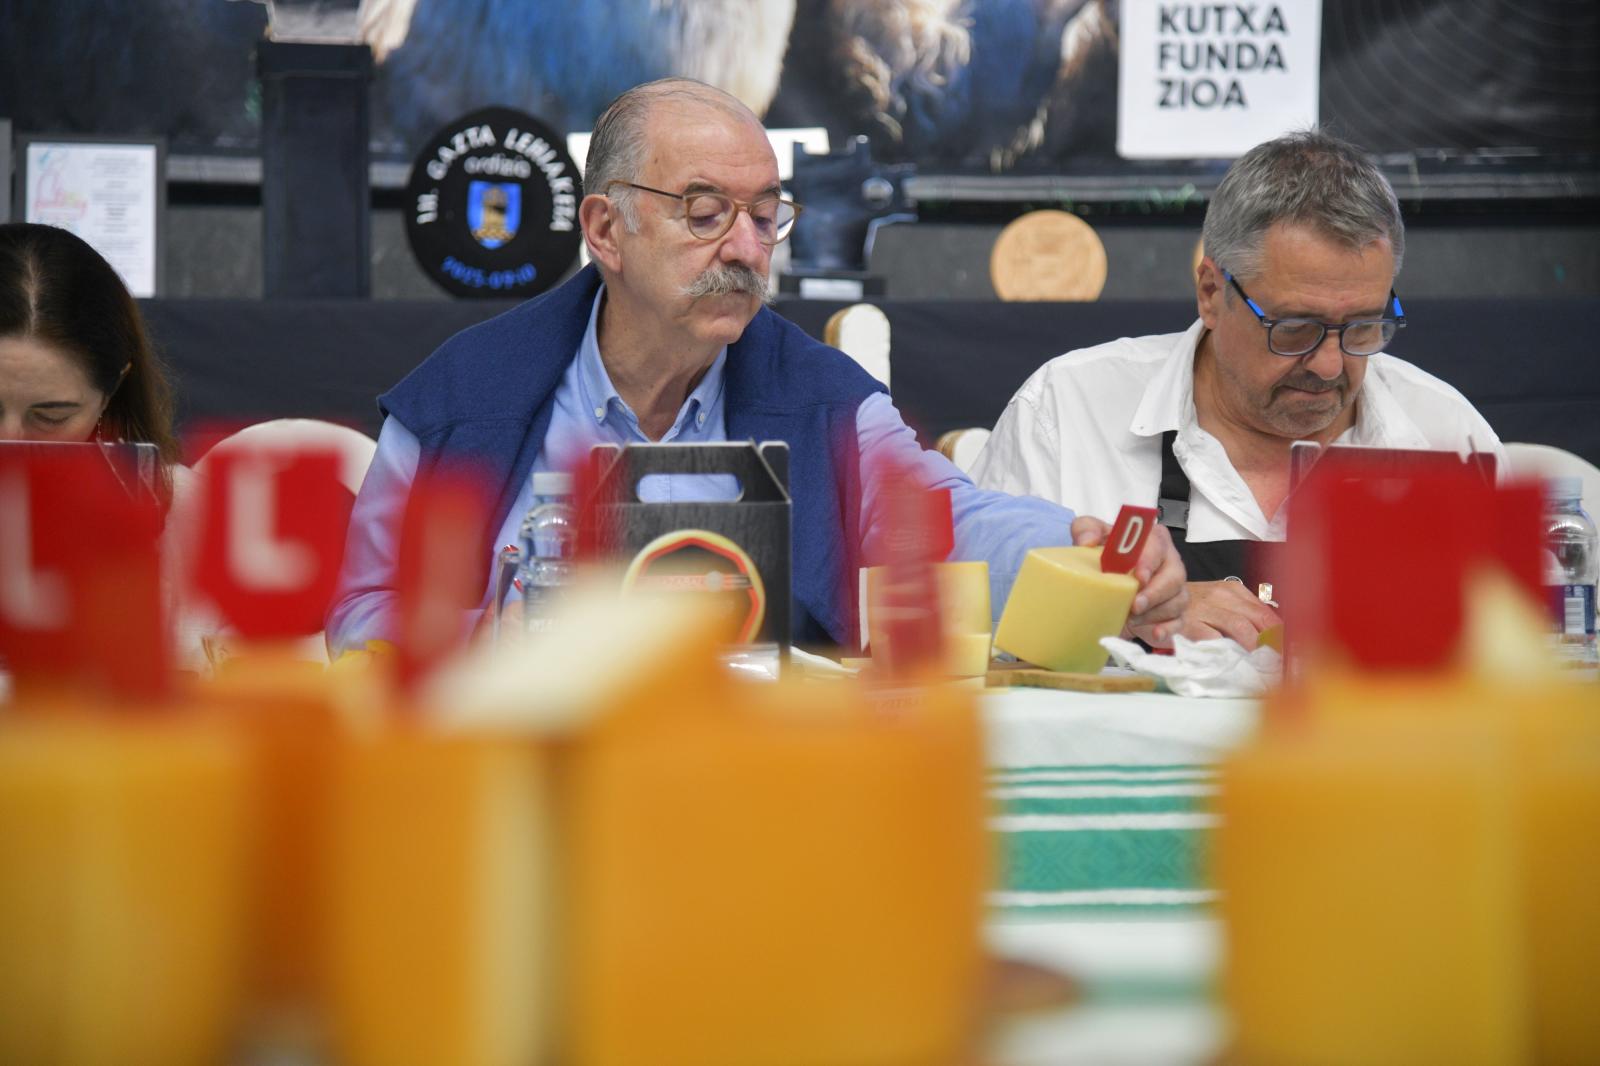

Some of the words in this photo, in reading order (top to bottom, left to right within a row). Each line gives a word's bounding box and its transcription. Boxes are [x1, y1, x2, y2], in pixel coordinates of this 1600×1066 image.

[1159, 5, 1288, 34] KUTXA
[1159, 43, 1286, 71] FUNDA
[1158, 79, 1246, 108] ZIOA
[426, 124, 497, 181] GAZTA
[1117, 516, 1143, 554] D
